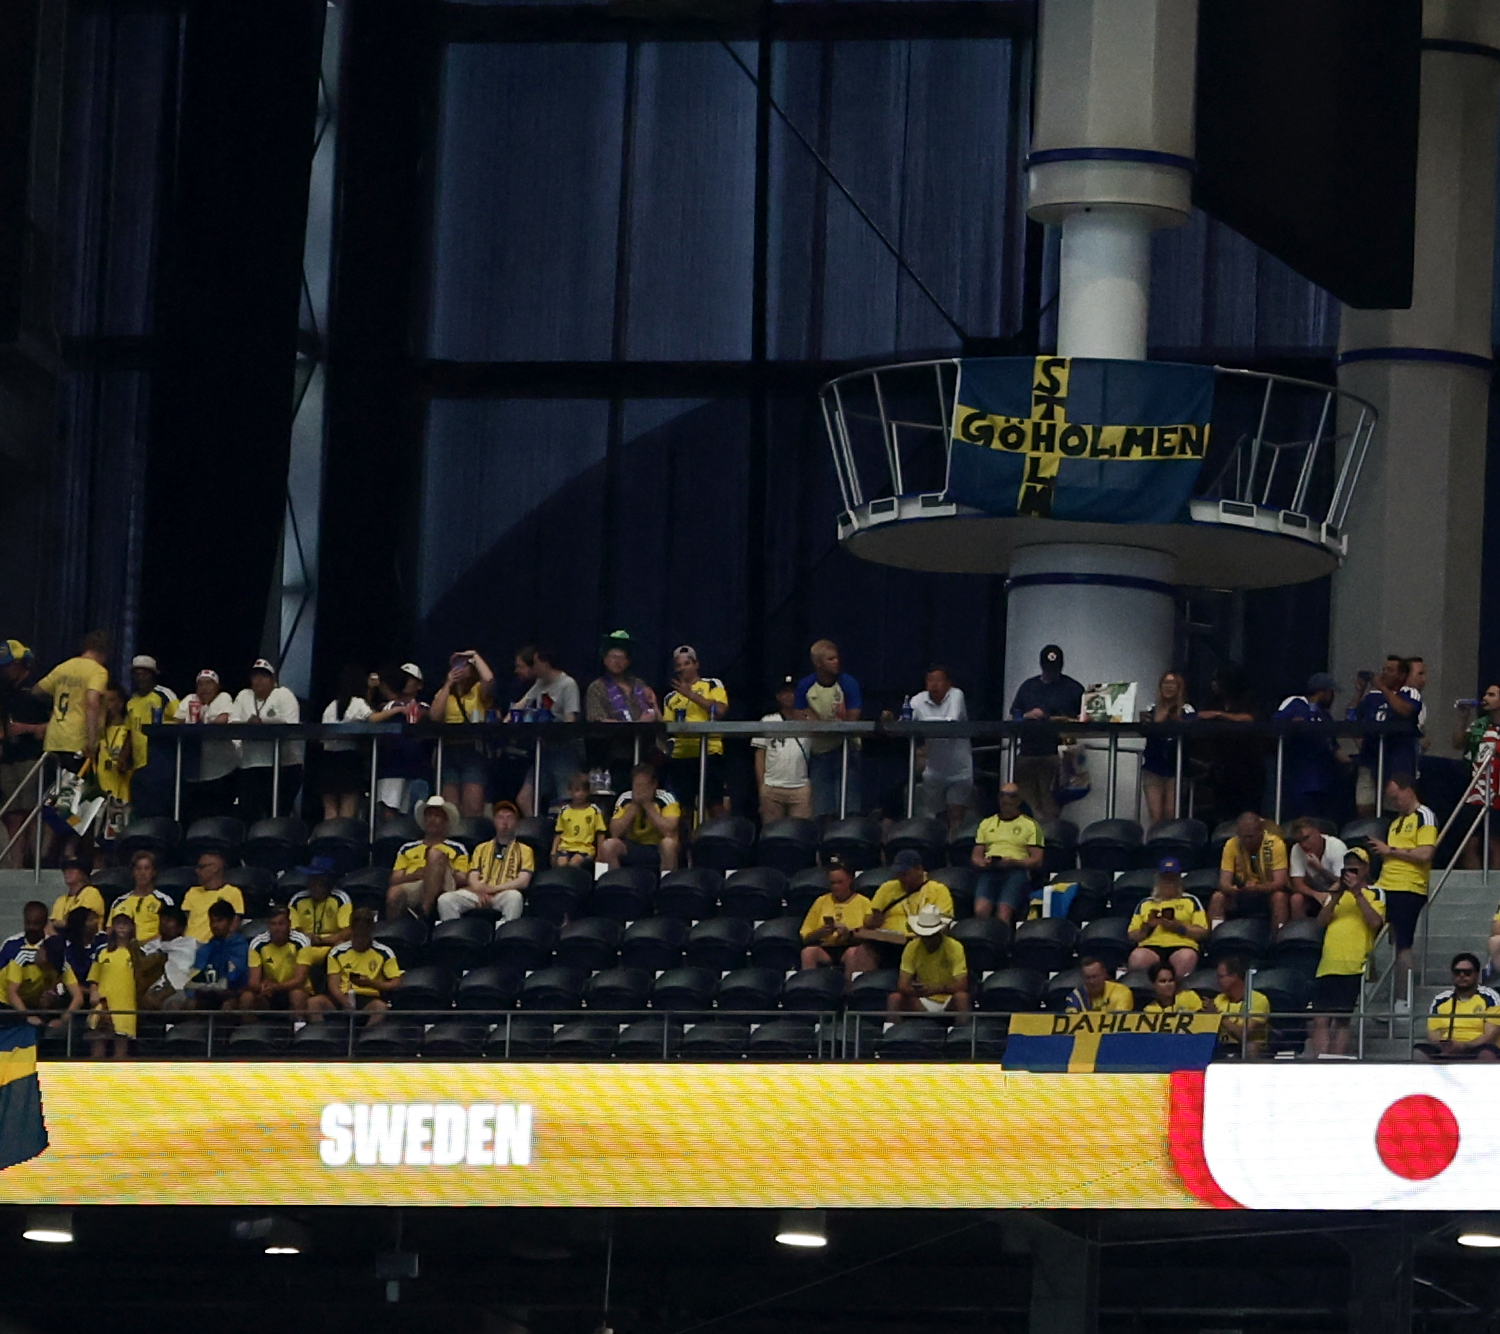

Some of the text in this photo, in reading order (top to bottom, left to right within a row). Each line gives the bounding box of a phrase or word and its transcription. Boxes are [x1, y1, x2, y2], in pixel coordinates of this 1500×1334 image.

[960, 411, 1205, 459] GÖHOLMEN
[1052, 1013, 1195, 1035] DAHLNER
[319, 1102, 533, 1167] SWEDEN
